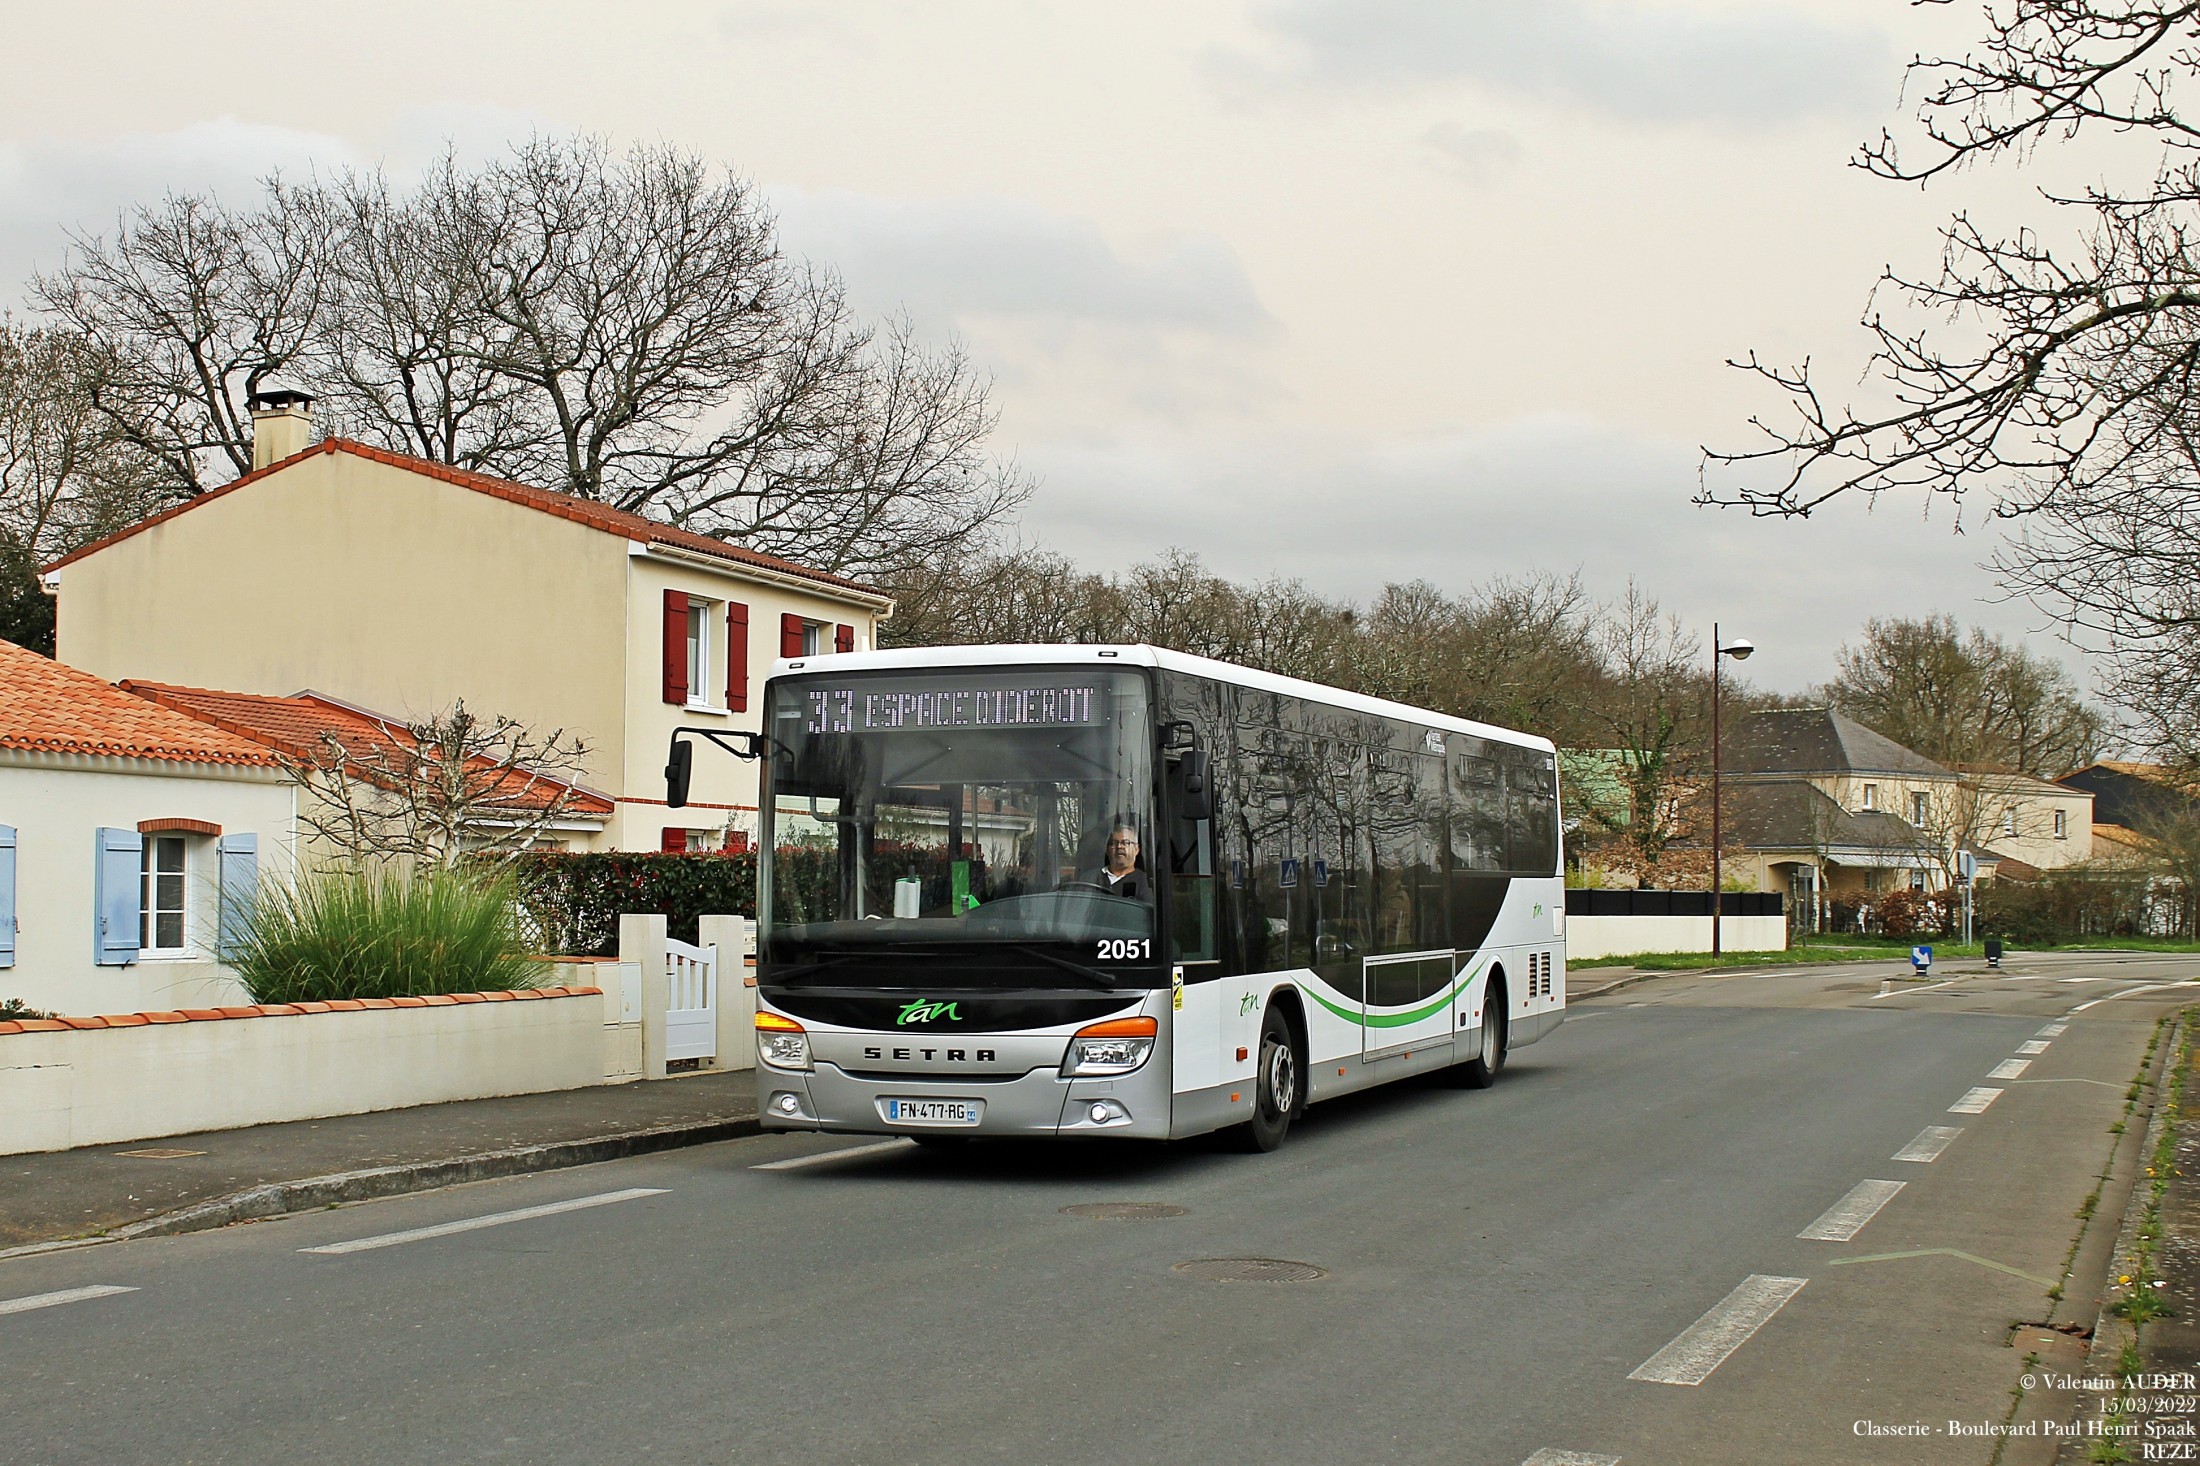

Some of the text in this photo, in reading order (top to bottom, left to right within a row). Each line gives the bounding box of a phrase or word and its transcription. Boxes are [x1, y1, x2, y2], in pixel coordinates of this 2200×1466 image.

[808, 686, 1095, 734] 33 ESPACE DIDEROT
[1097, 938, 1151, 960] 2051
[896, 998, 963, 1026] tan
[864, 1047, 996, 1062] SETRA
[900, 1102, 965, 1119] FN-477-RG
